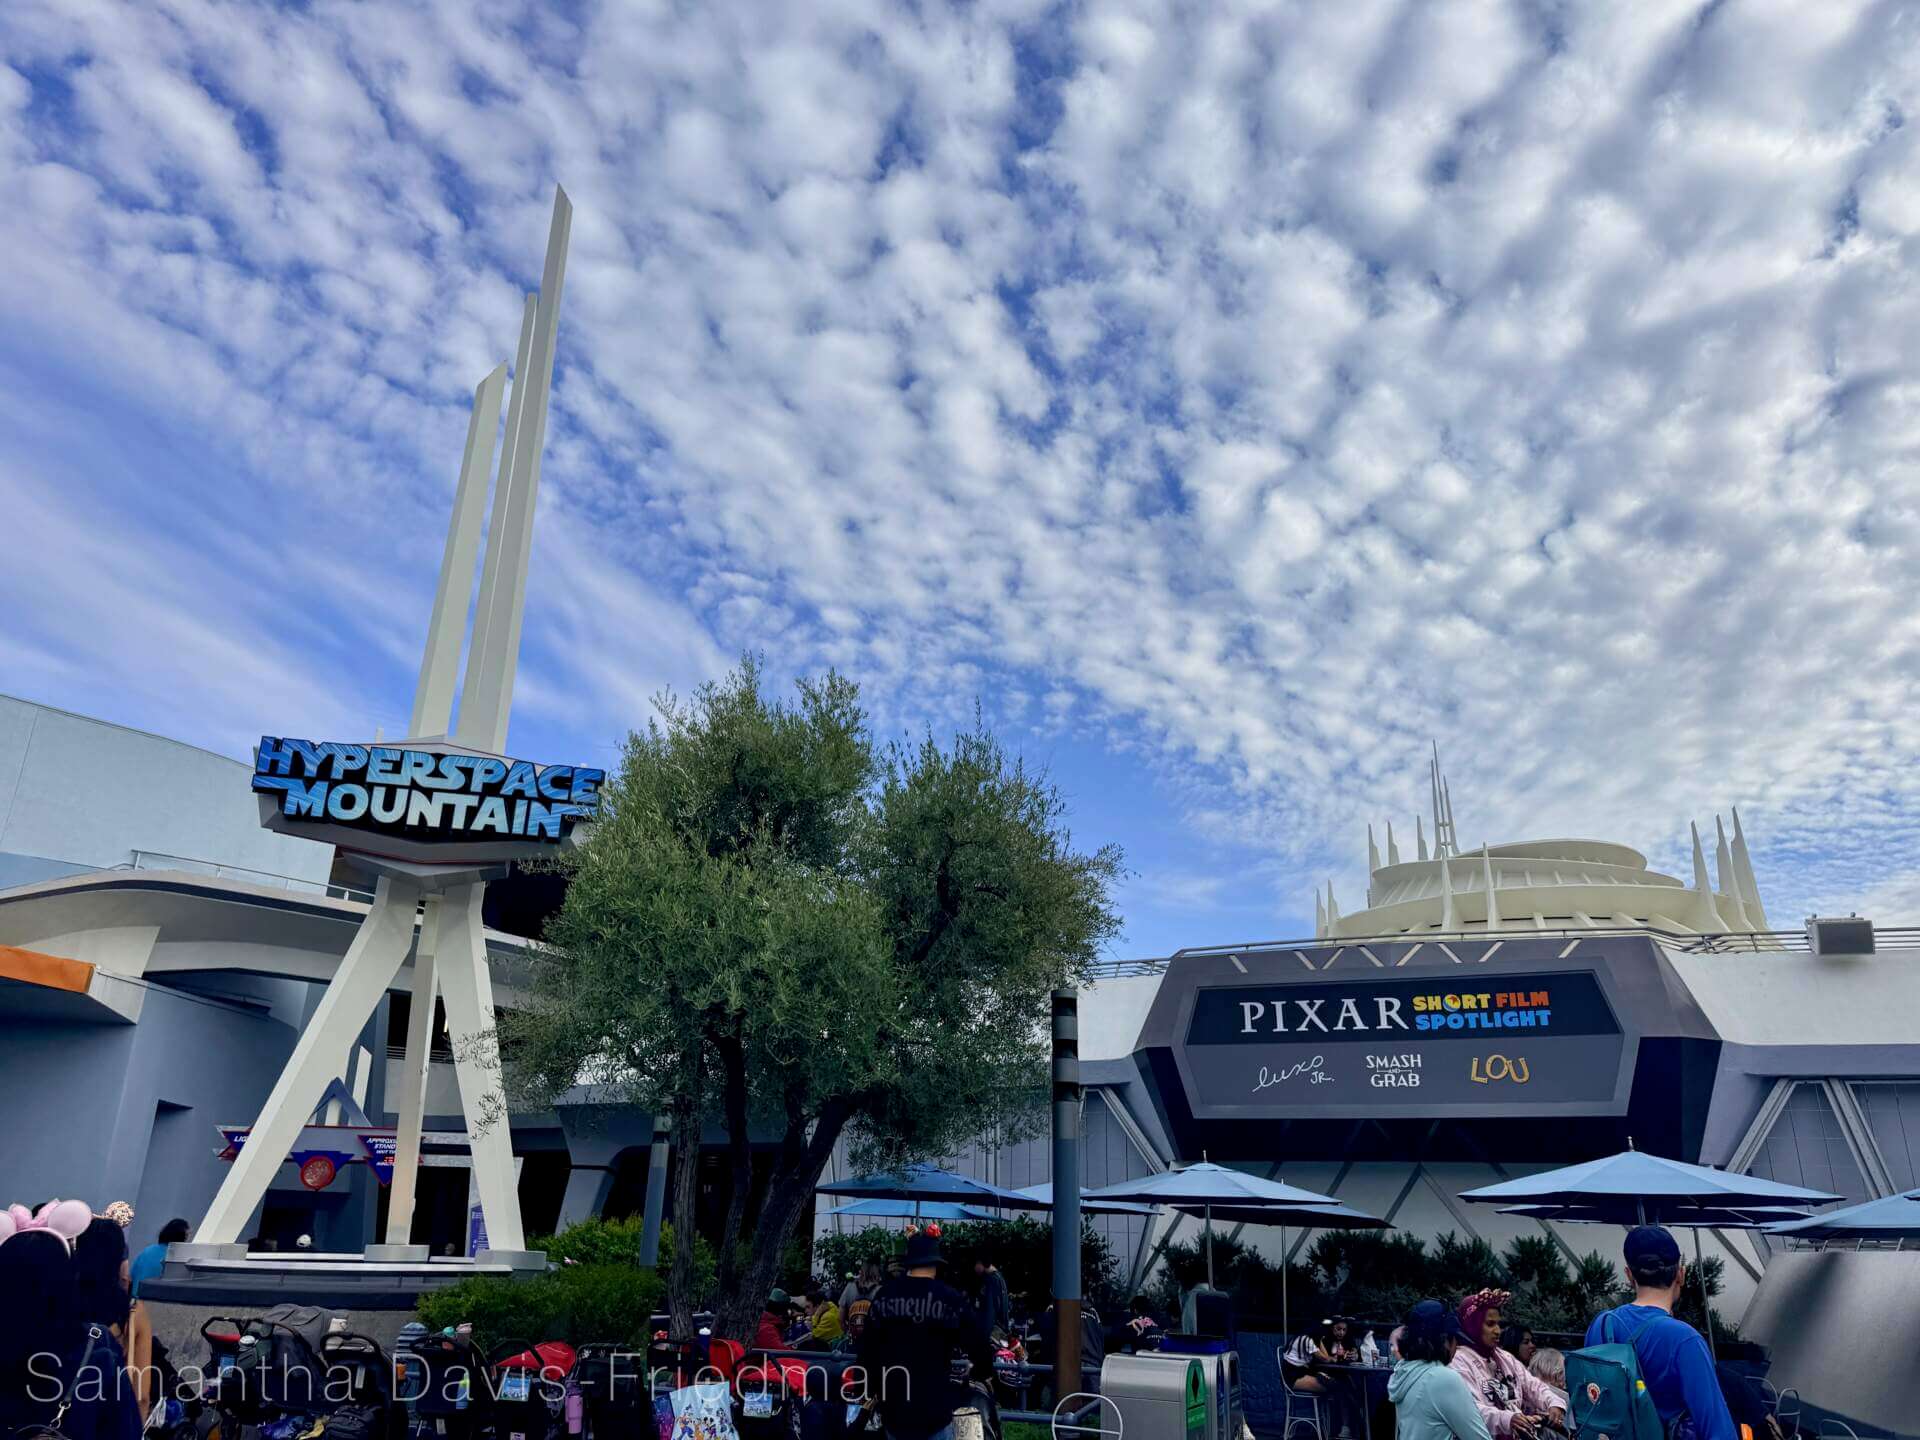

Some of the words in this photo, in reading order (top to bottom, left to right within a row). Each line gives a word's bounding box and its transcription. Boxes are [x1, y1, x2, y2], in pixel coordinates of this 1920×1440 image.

[255, 736, 604, 807] HYPERSPACE
[253, 775, 599, 839] MOUNTAIN
[1240, 996, 1410, 1033] PIXAR
[1412, 993, 1491, 1012] SHORT
[1496, 991, 1550, 1008] FILM
[1415, 1009, 1551, 1030] SPOTLIGHT
[1365, 1053, 1422, 1069] SMASH
[1470, 1053, 1530, 1084] LOU
[1370, 1073, 1421, 1088] GRAB
